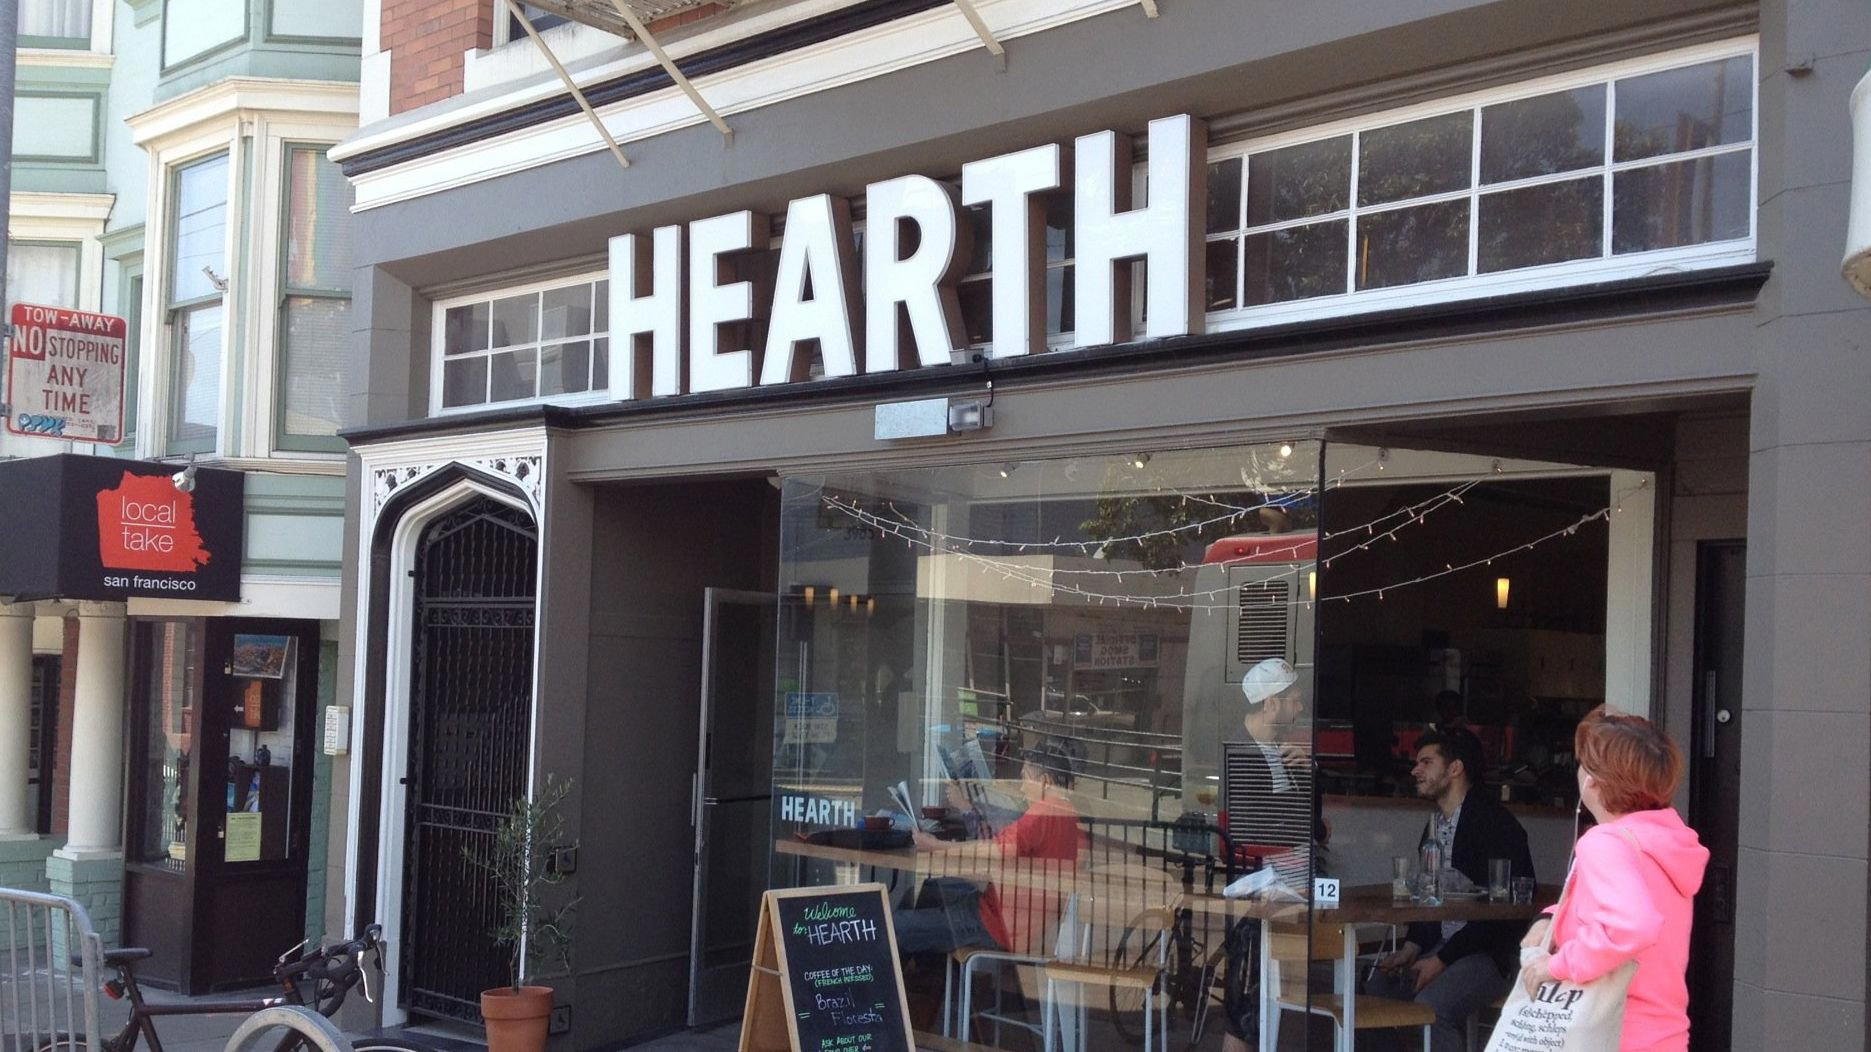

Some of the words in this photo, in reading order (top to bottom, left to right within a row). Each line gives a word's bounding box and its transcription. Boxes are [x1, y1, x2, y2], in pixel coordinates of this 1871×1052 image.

[608, 113, 1191, 401] HEARTH
[24, 306, 115, 332] TOW-AWAY
[13, 324, 43, 355] NO
[49, 336, 120, 365] STOPPING
[47, 364, 88, 389] ANY
[42, 389, 91, 415] TIME
[121, 496, 176, 523] local
[122, 527, 173, 552] take
[104, 576, 129, 588] san
[133, 574, 197, 591] francisco
[781, 795, 856, 827] HEARTH
[1318, 883, 1337, 898] 12
[804, 902, 857, 920] Welcome
[808, 919, 877, 945] HEARTH
[804, 968, 830, 981] COFFEE
[832, 968, 839, 977] OF
[841, 966, 855, 977] THE
[815, 986, 855, 1010] Brazil
[831, 1008, 884, 1025] Floresta
[836, 1036, 855, 1045] ABOUT
[858, 1034, 872, 1042] OUR
